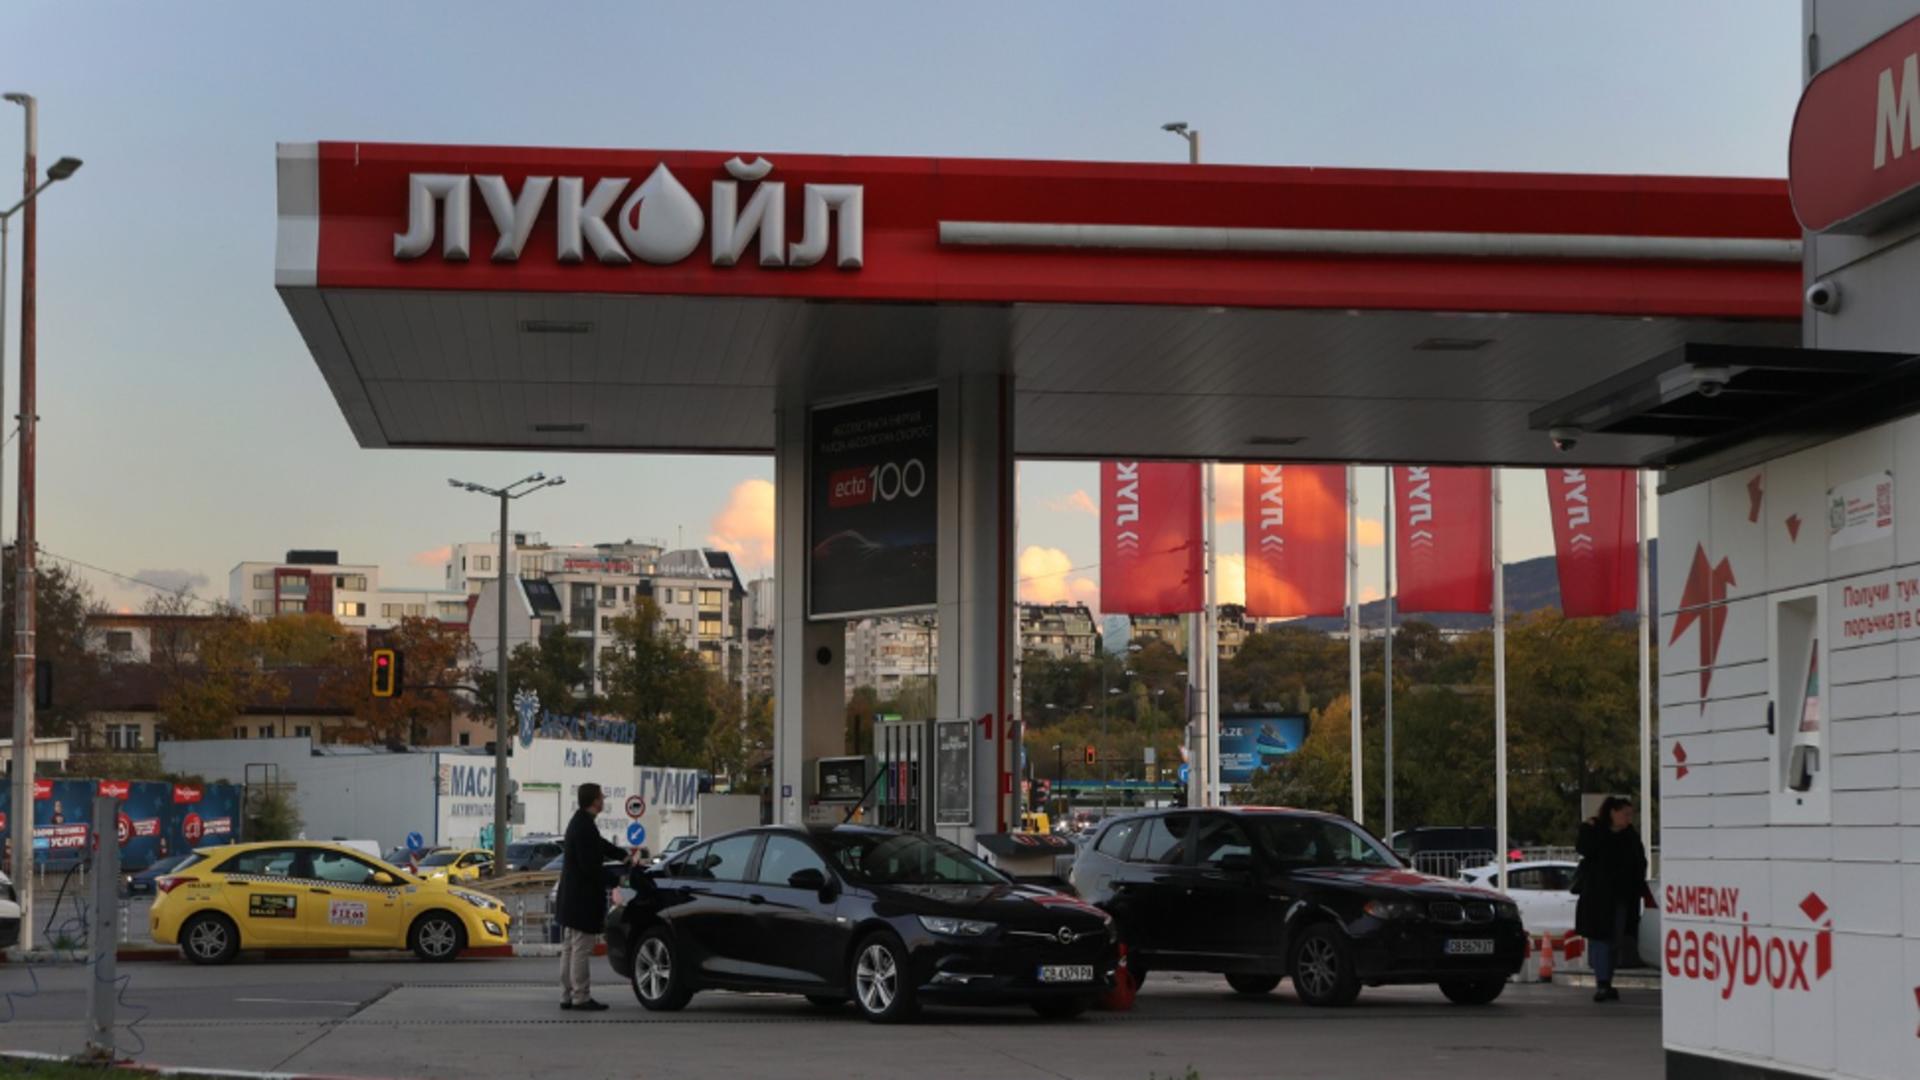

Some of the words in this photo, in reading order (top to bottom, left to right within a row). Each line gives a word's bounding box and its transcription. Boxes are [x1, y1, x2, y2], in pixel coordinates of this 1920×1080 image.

[869, 458, 925, 503] 100
[1843, 583, 1889, 608] Получи
[1897, 578, 1919, 602] тук
[1844, 610, 1911, 640] поръчката
[978, 713, 993, 740] 1
[451, 765, 509, 797] МАСЛ
[640, 770, 697, 805] ГУМИ
[1666, 885, 1740, 917] SAMEDAY
[1665, 911, 1810, 1000] easybox
